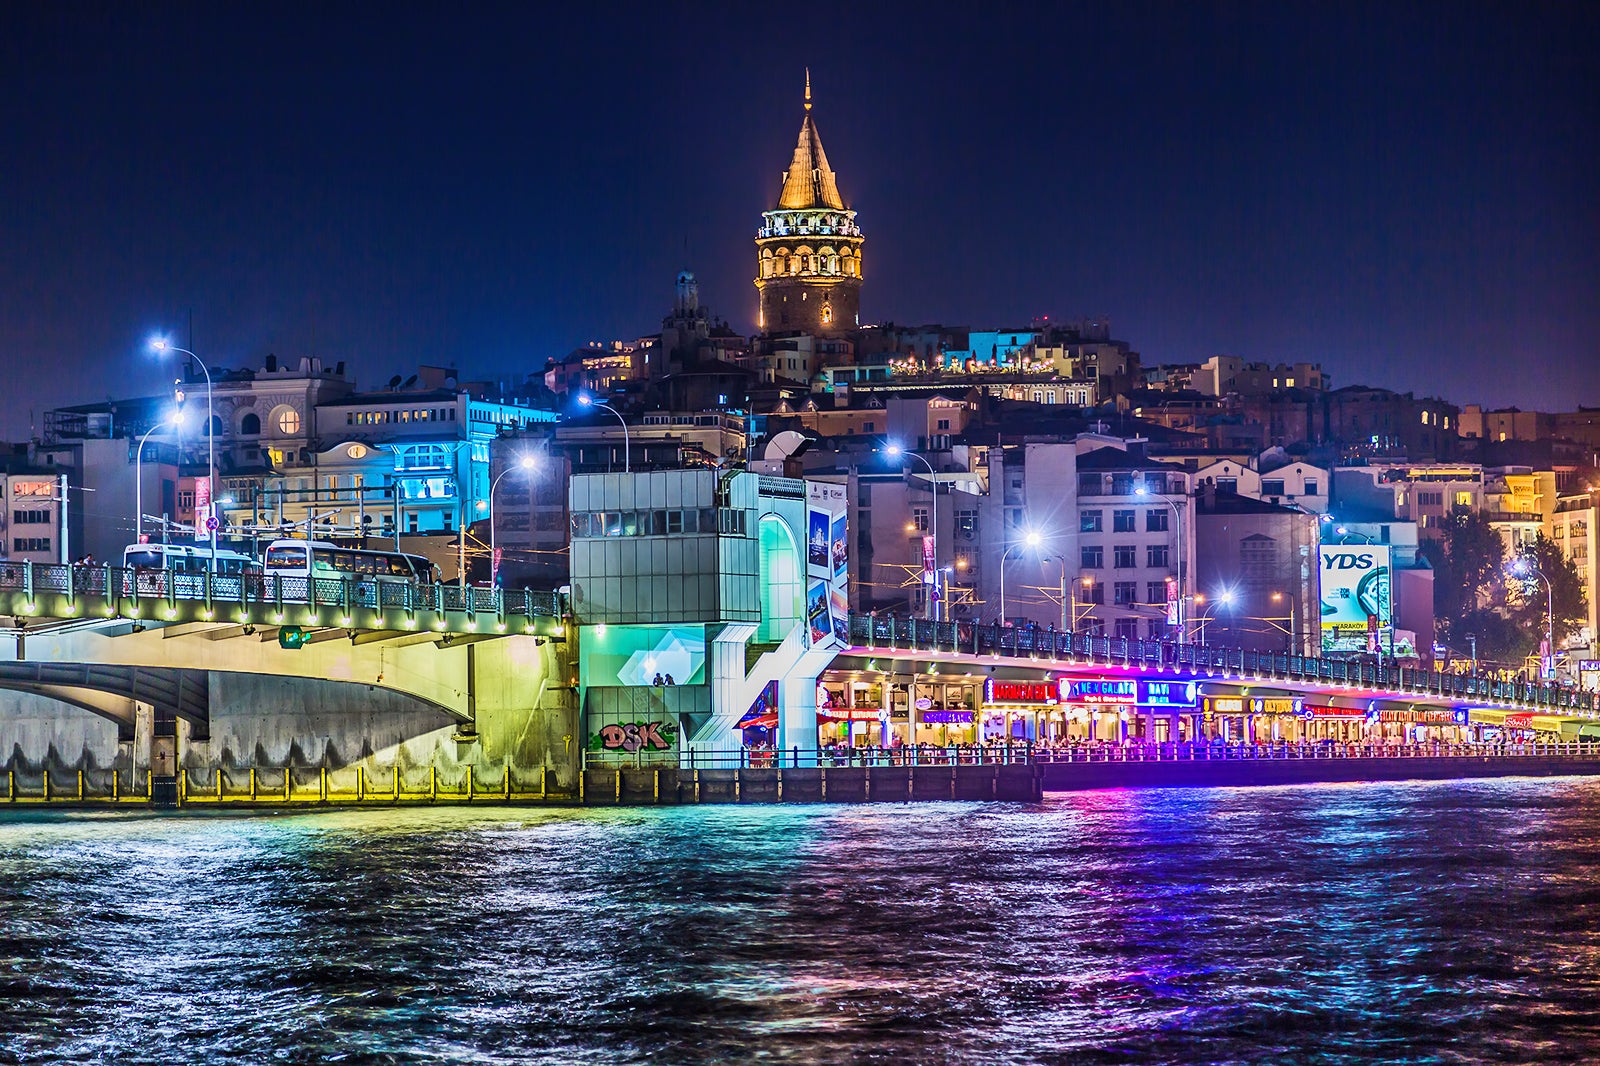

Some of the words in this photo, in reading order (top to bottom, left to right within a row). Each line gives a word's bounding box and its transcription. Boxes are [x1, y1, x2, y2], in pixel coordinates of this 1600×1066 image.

[1323, 554, 1373, 569] YDS
[1101, 682, 1134, 695] GALATA
[599, 721, 671, 751] DSK
